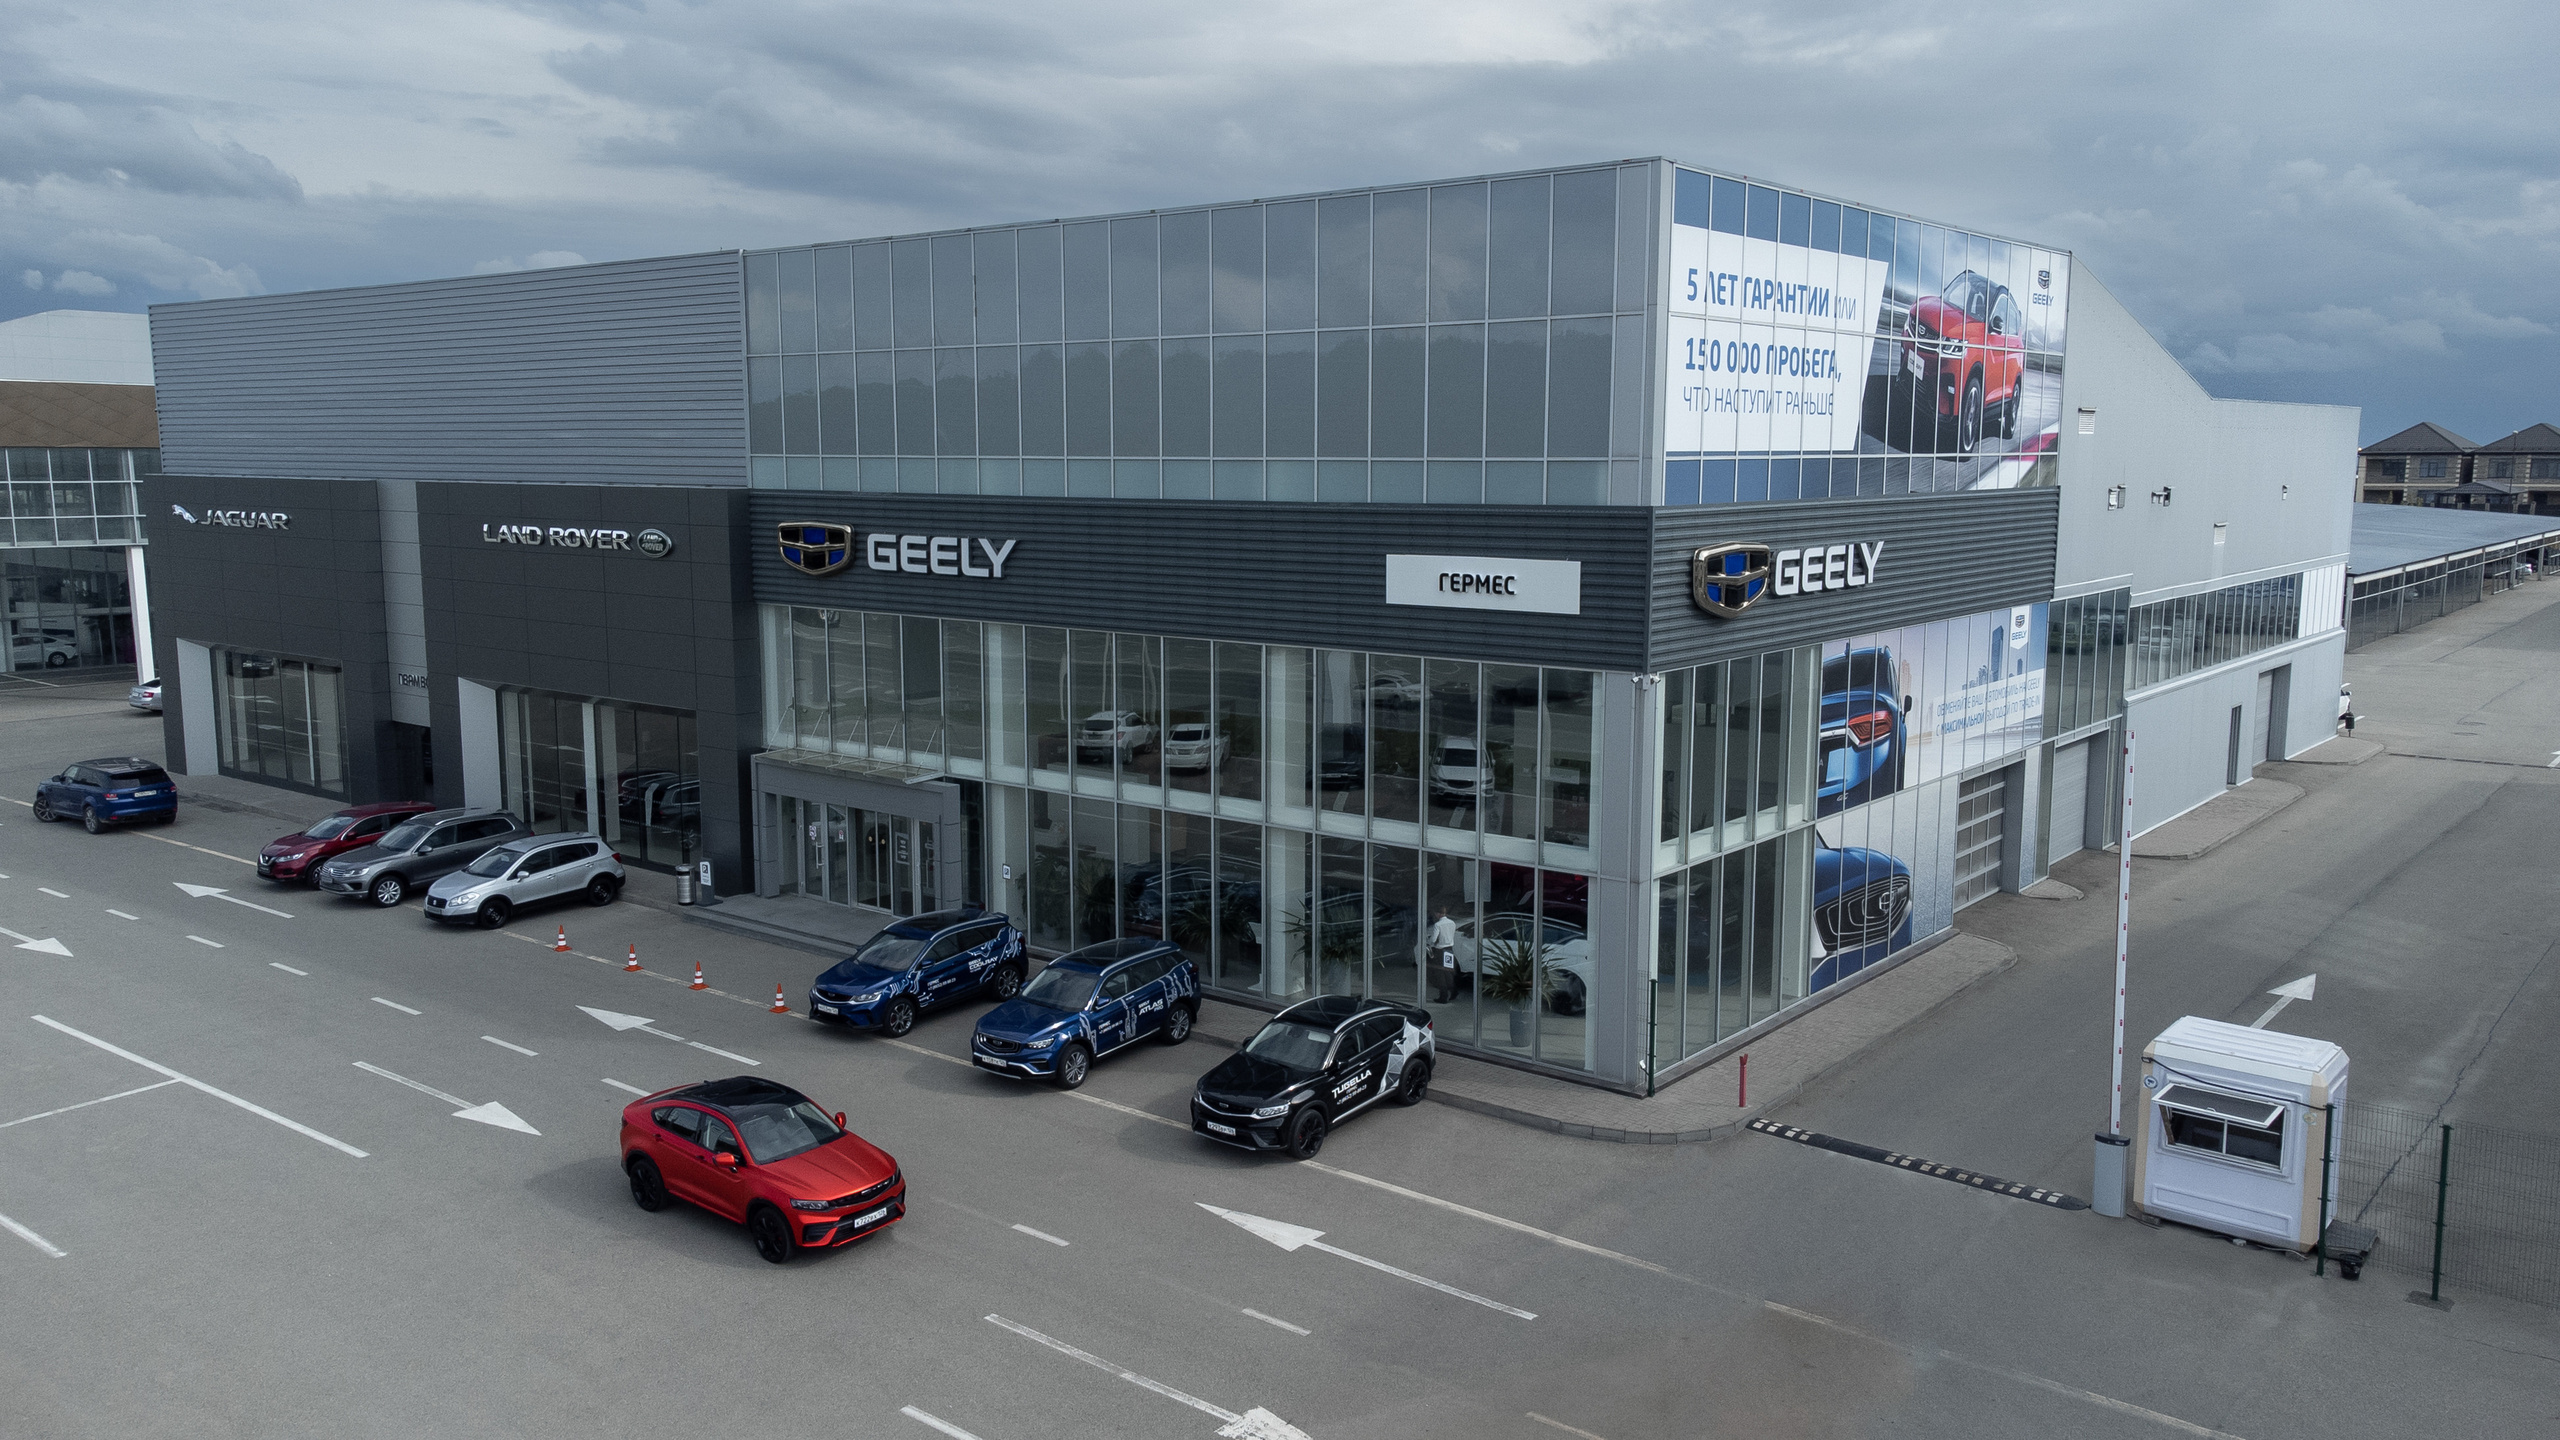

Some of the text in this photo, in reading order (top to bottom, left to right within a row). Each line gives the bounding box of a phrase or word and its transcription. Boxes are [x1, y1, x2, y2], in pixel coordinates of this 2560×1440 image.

[1687, 267, 1698, 302] 5
[1703, 270, 1739, 307] ЛЕТ
[1742, 275, 1830, 318] ГАРАНТИИ
[2032, 292, 2055, 306] GEELY
[1685, 337, 1842, 383] 150 000 ПРОБЕГА,
[1713, 387, 1783, 414] НАСТУПИТ
[200, 509, 290, 530] JAGUAR
[483, 523, 633, 551] LAND ROVER
[866, 532, 1018, 579] GEELY
[1774, 540, 1885, 597] GEELY
[1438, 572, 1516, 596] ГЕРМЕС
[1139, 998, 1164, 1016] ATLAS
[1331, 1069, 1373, 1099] TUGELLA
